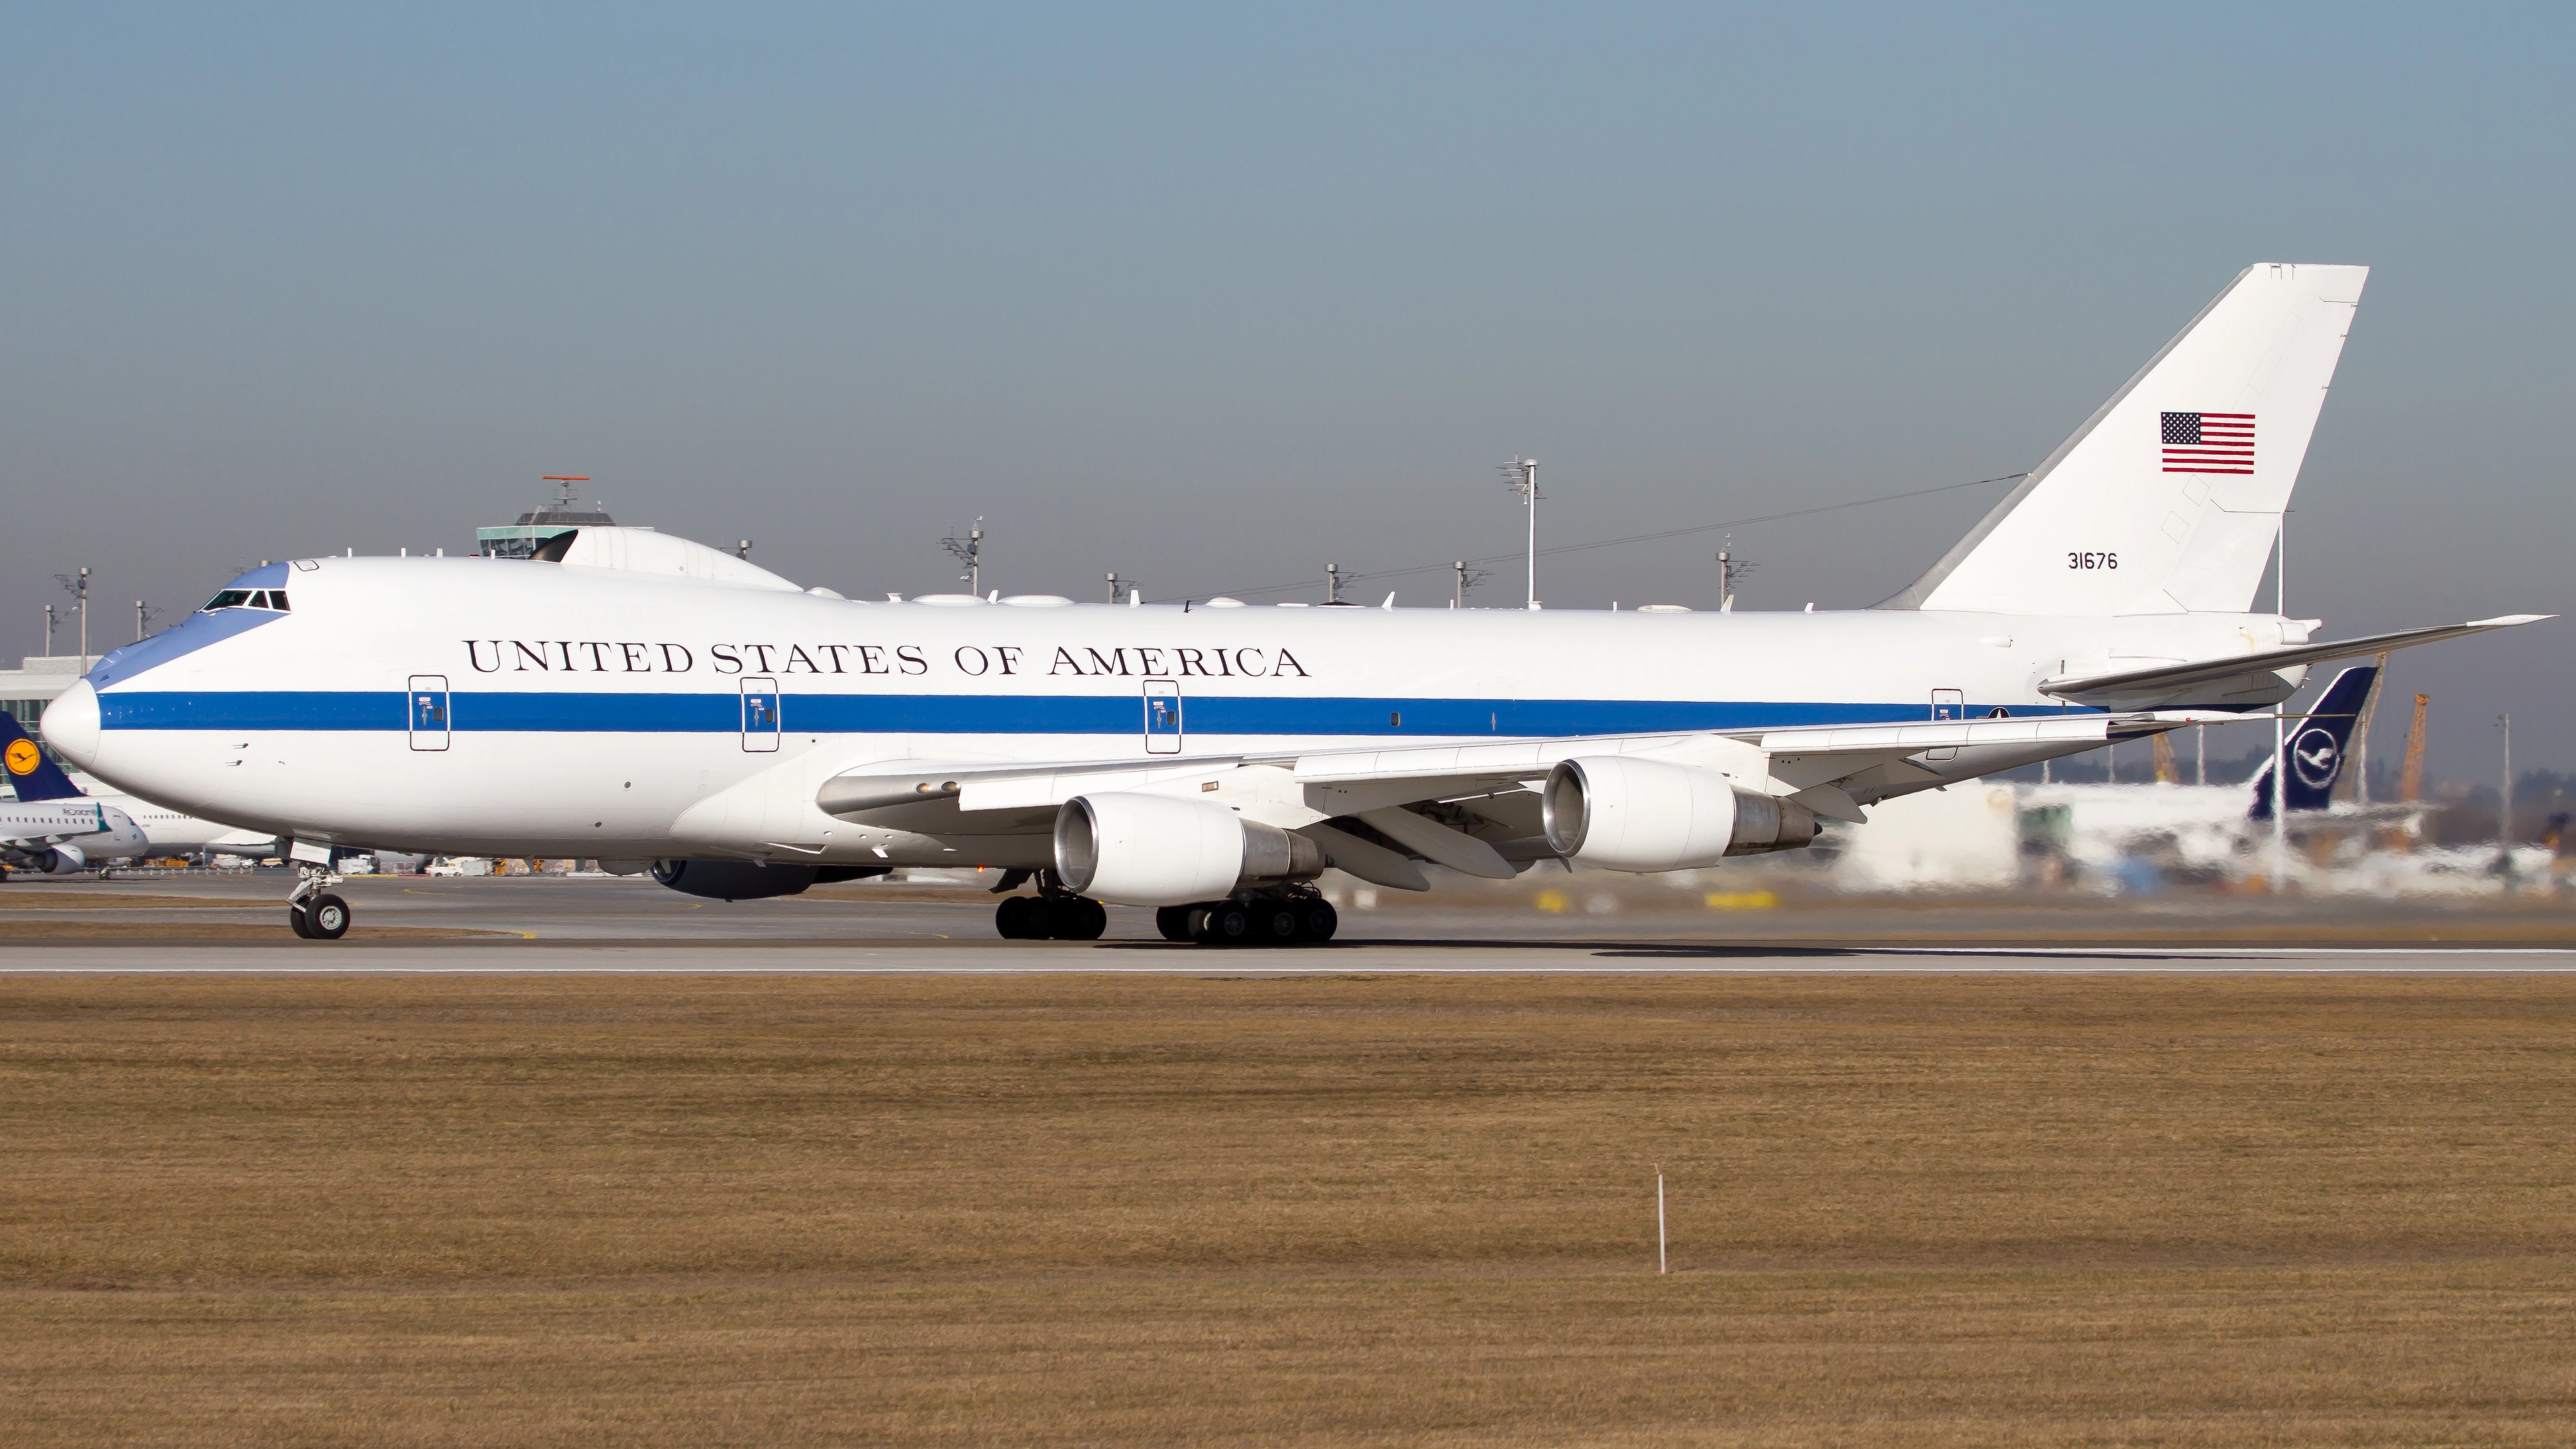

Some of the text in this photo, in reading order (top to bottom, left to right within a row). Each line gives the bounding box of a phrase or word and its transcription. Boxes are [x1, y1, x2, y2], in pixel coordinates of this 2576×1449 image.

[2068, 552, 2118, 570] 31676
[462, 639, 1312, 678] UNITED STATES OF AMERICA
